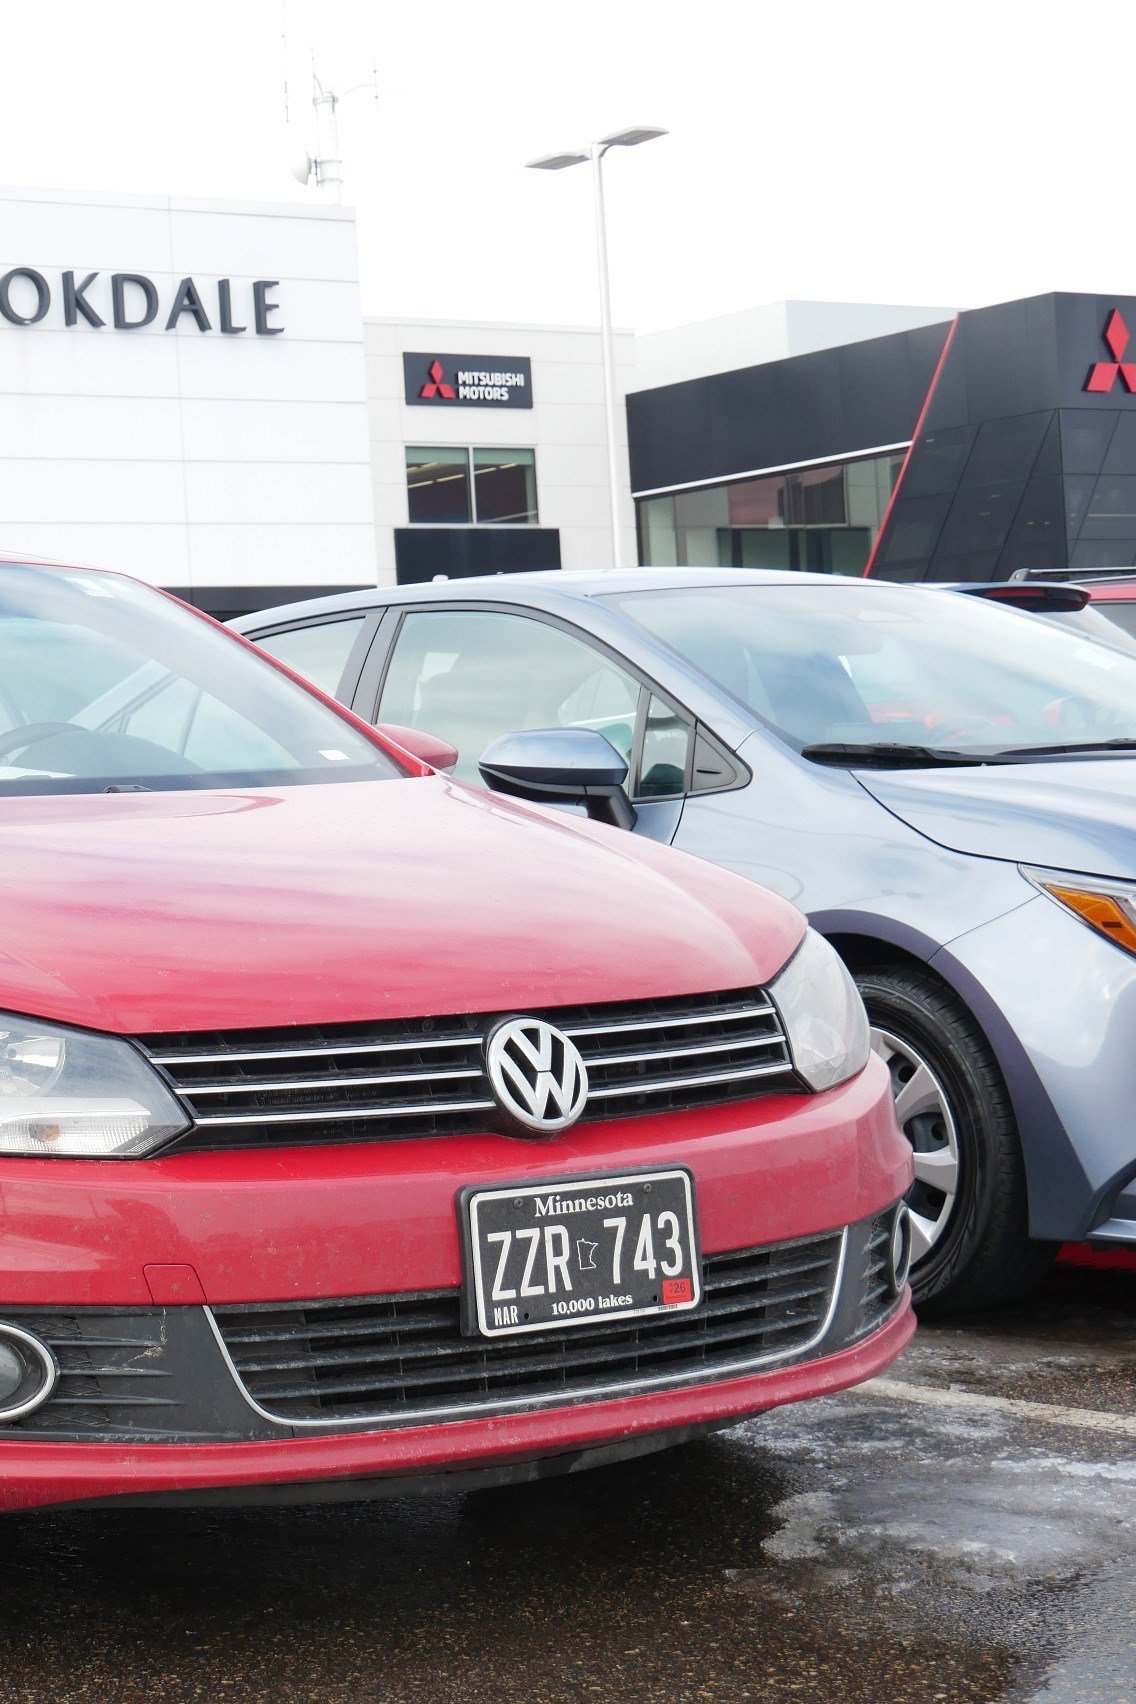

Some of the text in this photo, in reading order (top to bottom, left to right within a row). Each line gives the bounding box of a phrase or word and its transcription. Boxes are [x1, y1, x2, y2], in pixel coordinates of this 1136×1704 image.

[457, 371, 525, 387] MITSUBISHI
[458, 386, 509, 401] MOTORS
[534, 1190, 633, 1217] Minnesota
[487, 1210, 683, 1301] ZZR 743
[673, 1281, 686, 1294] 26
[551, 1293, 633, 1316] 10,000 lakes
[494, 1305, 519, 1326] MAR
